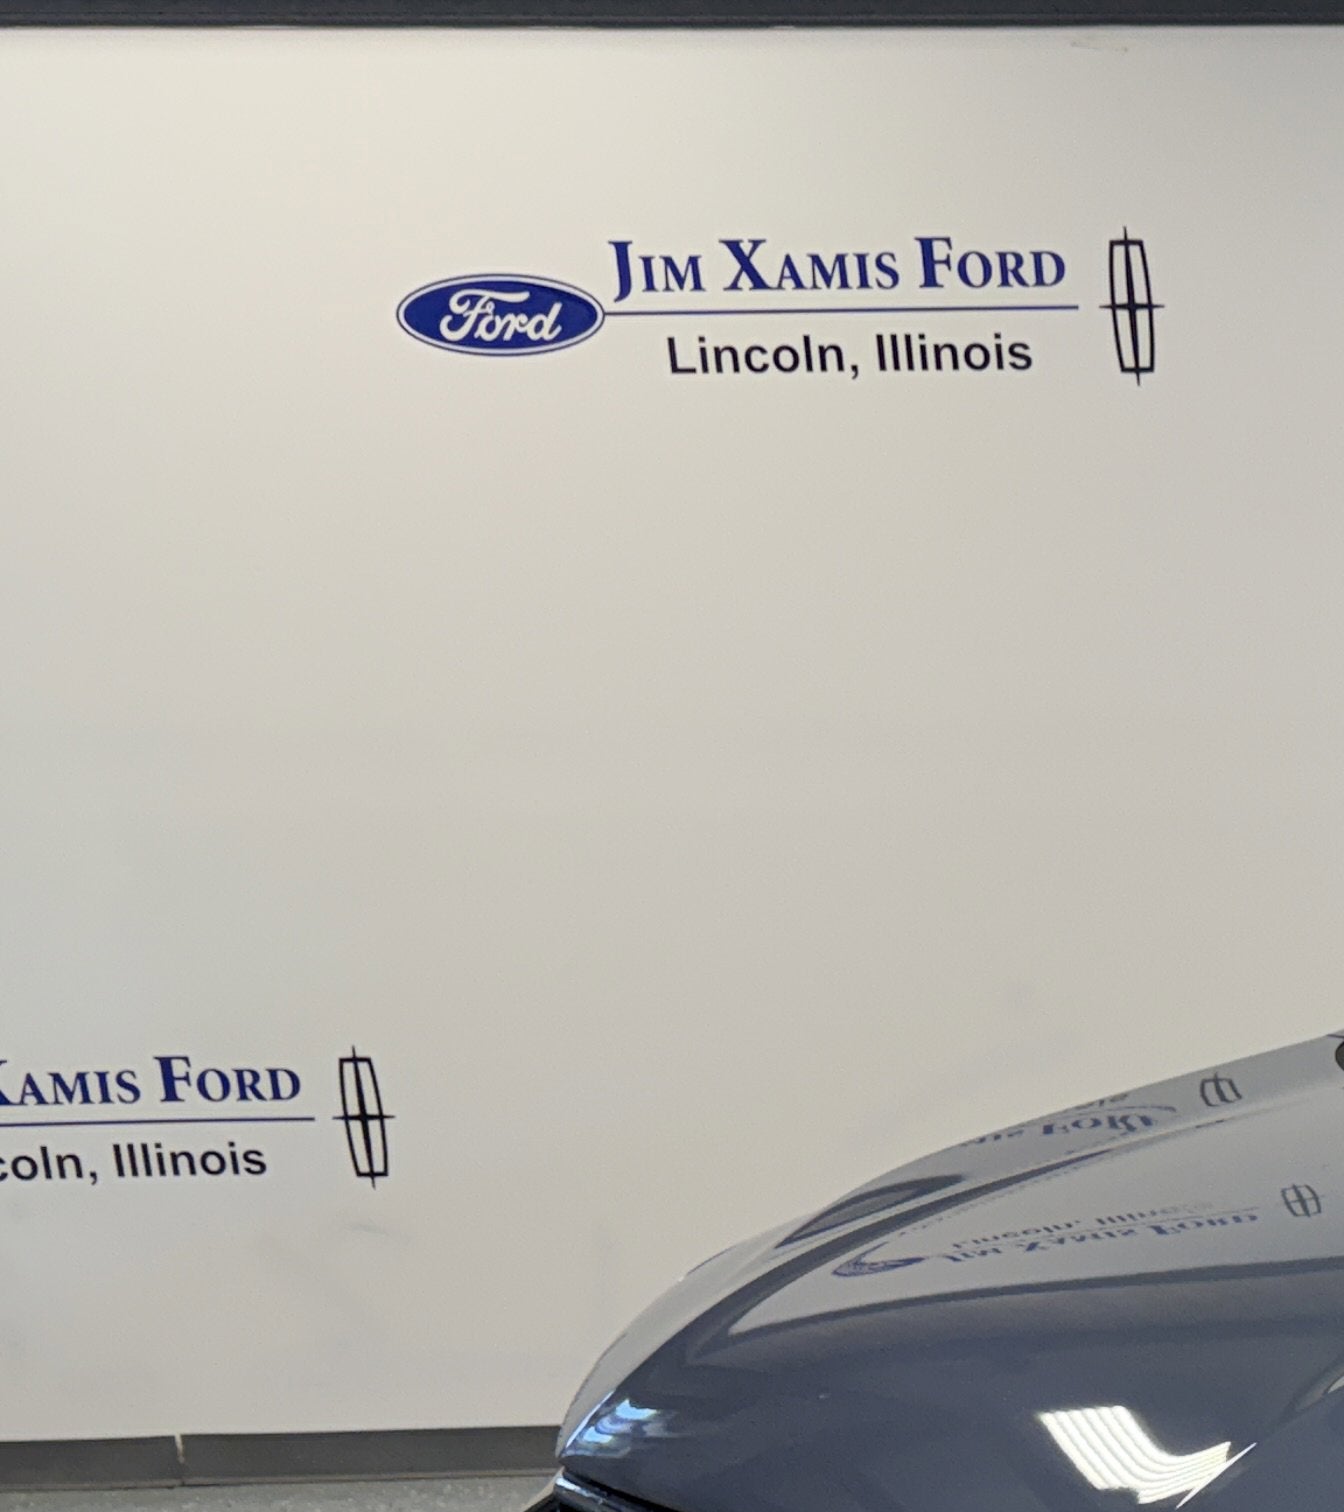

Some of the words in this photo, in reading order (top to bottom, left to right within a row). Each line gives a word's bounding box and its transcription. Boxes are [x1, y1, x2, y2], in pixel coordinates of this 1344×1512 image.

[608, 241, 705, 303] JIM
[719, 239, 900, 291] XAMIS
[914, 236, 1066, 289] FORD
[439, 288, 563, 343] Ford
[667, 335, 860, 379] Lincoln,
[876, 333, 1033, 371] Illinois
[0, 1060, 141, 1106] AMIS
[154, 1056, 302, 1103] FORD
[112, 1141, 267, 1178] Illinois
